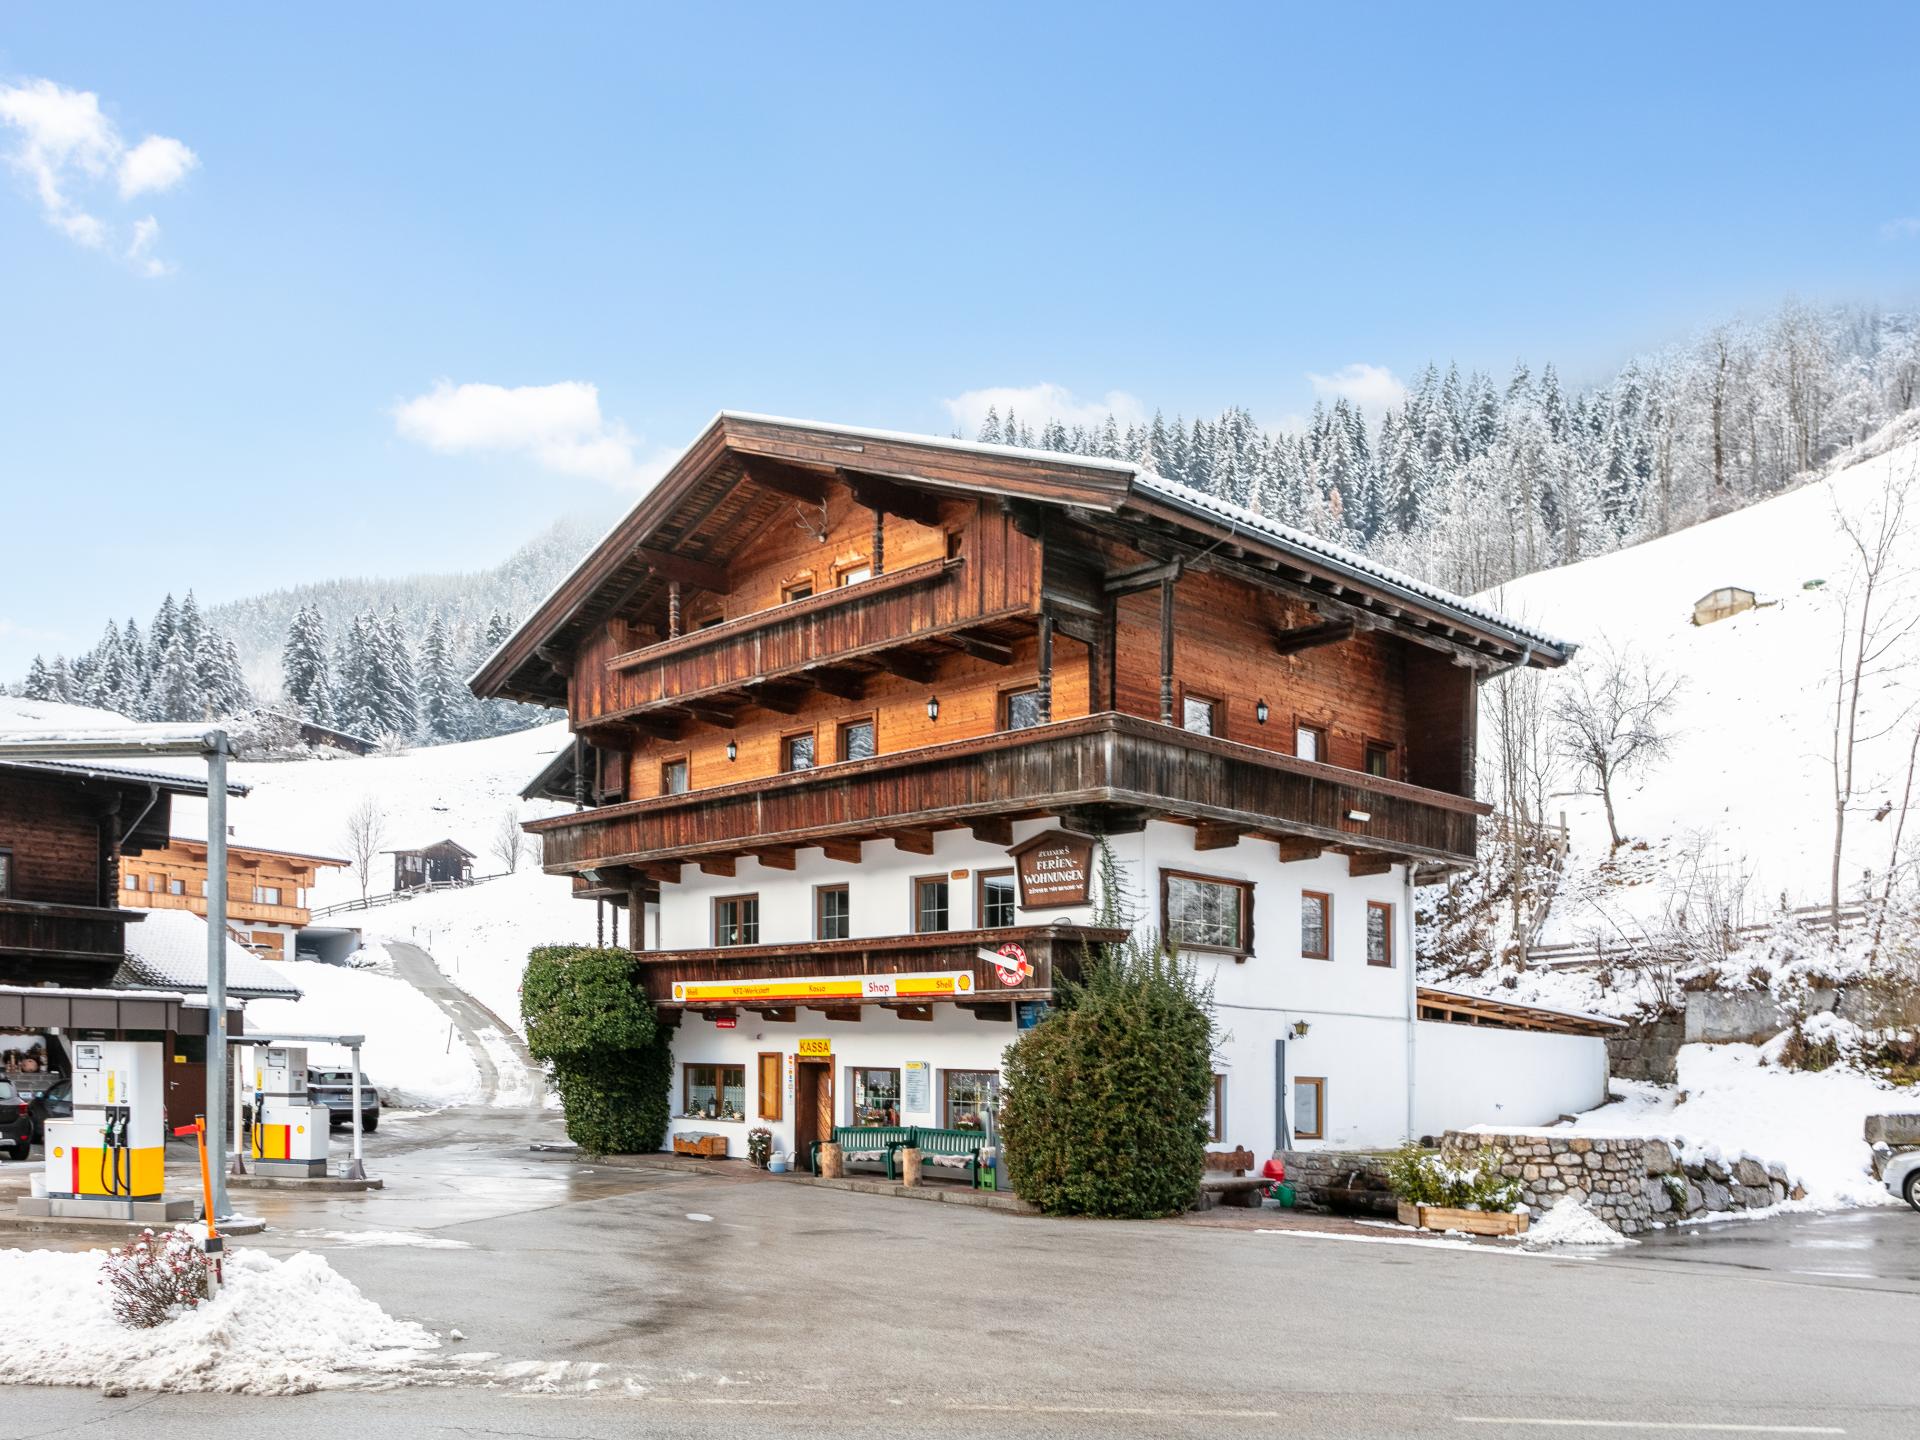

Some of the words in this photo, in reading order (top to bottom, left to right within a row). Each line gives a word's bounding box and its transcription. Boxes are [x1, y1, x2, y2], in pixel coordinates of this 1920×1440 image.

[1023, 869, 1084, 885] WOHNUNGEN
[999, 944, 1025, 963] TABAK
[998, 967, 1025, 984] TRAFIK
[868, 981, 890, 995] Shop
[936, 979, 953, 989] Shell
[800, 1041, 829, 1053] KASSA
